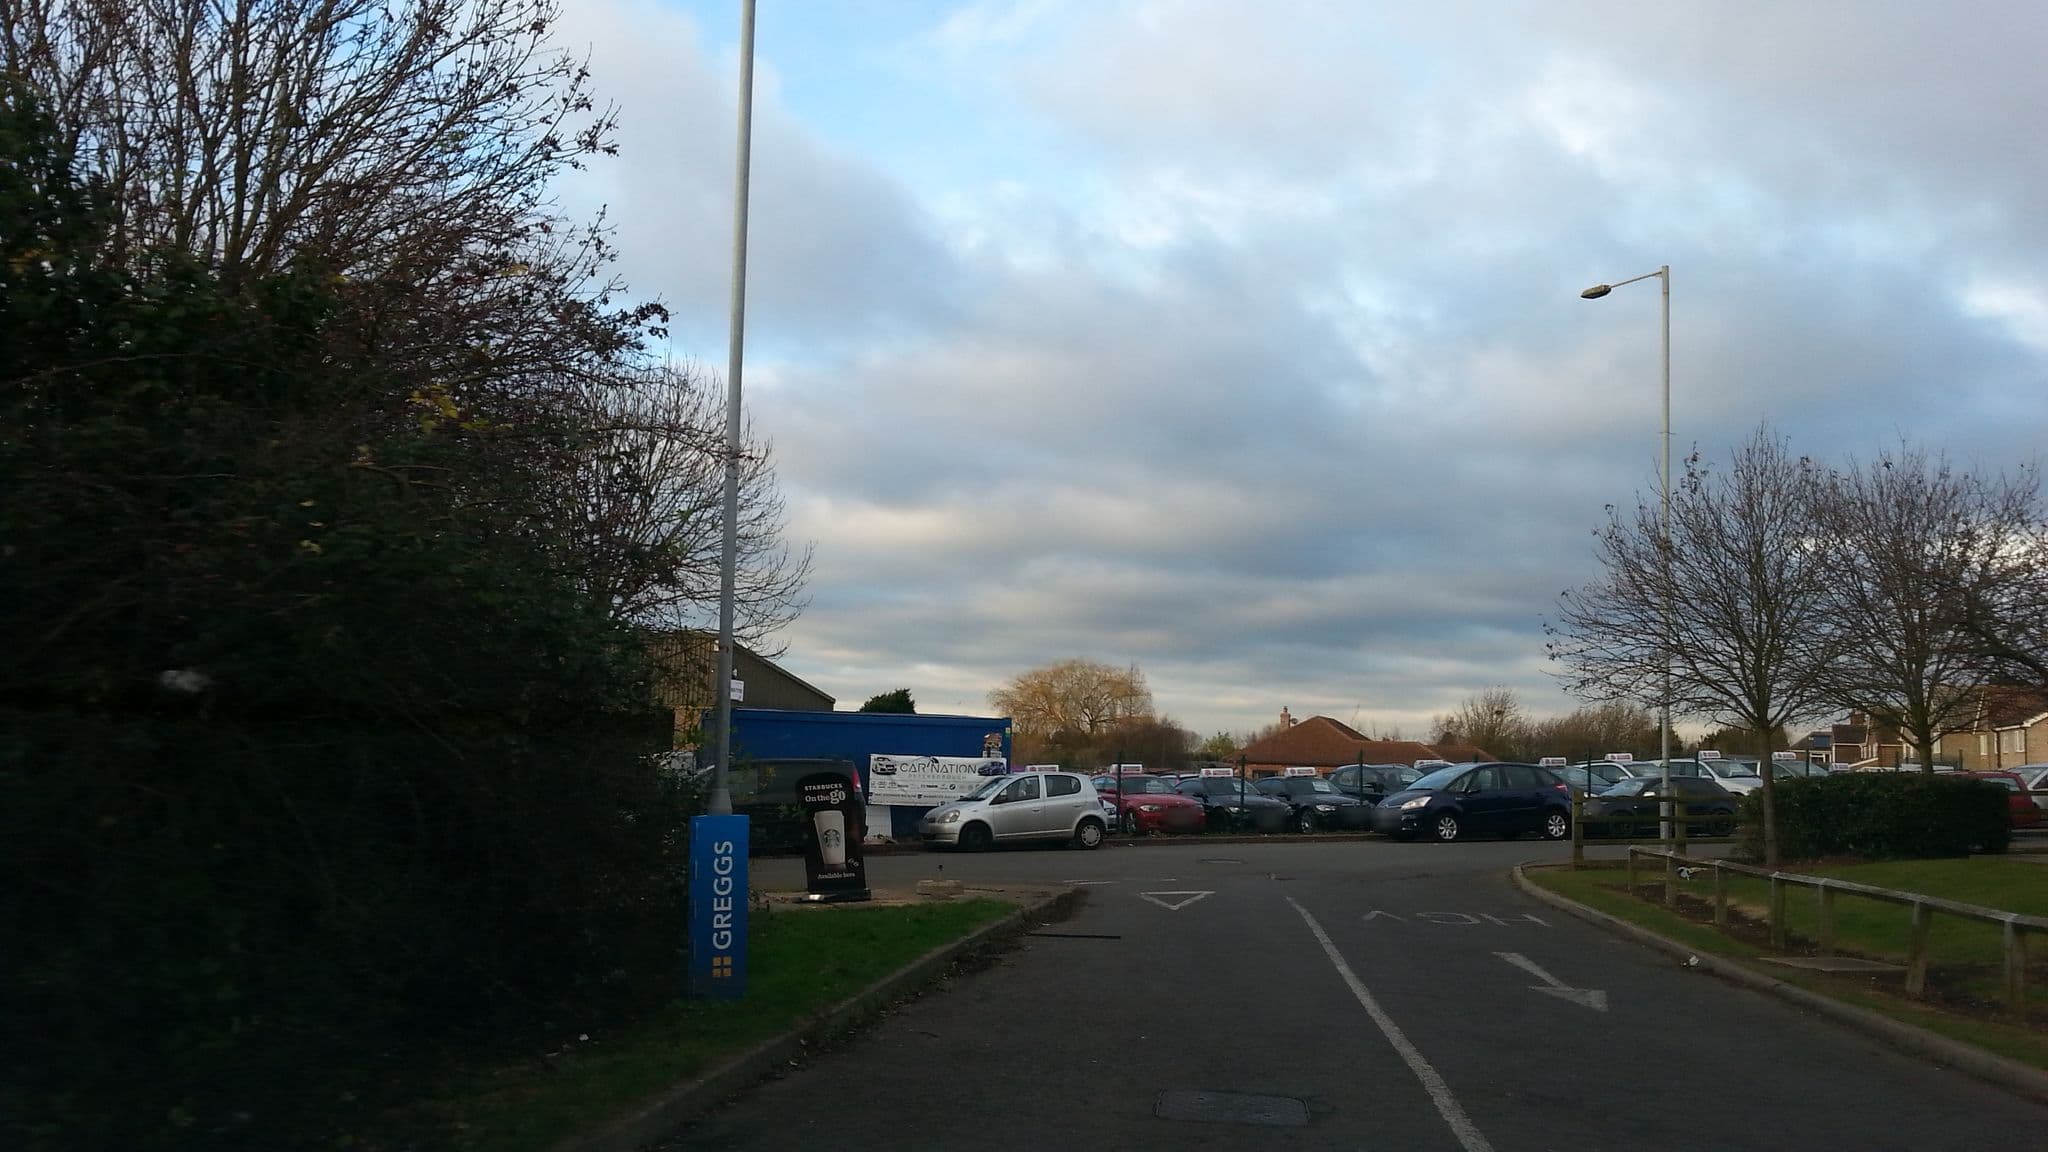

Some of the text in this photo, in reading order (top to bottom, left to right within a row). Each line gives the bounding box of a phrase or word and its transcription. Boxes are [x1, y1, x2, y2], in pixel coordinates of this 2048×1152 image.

[804, 783, 843, 791] STARBUCKS
[805, 789, 846, 804] On the go
[712, 840, 734, 950] GREGGS
